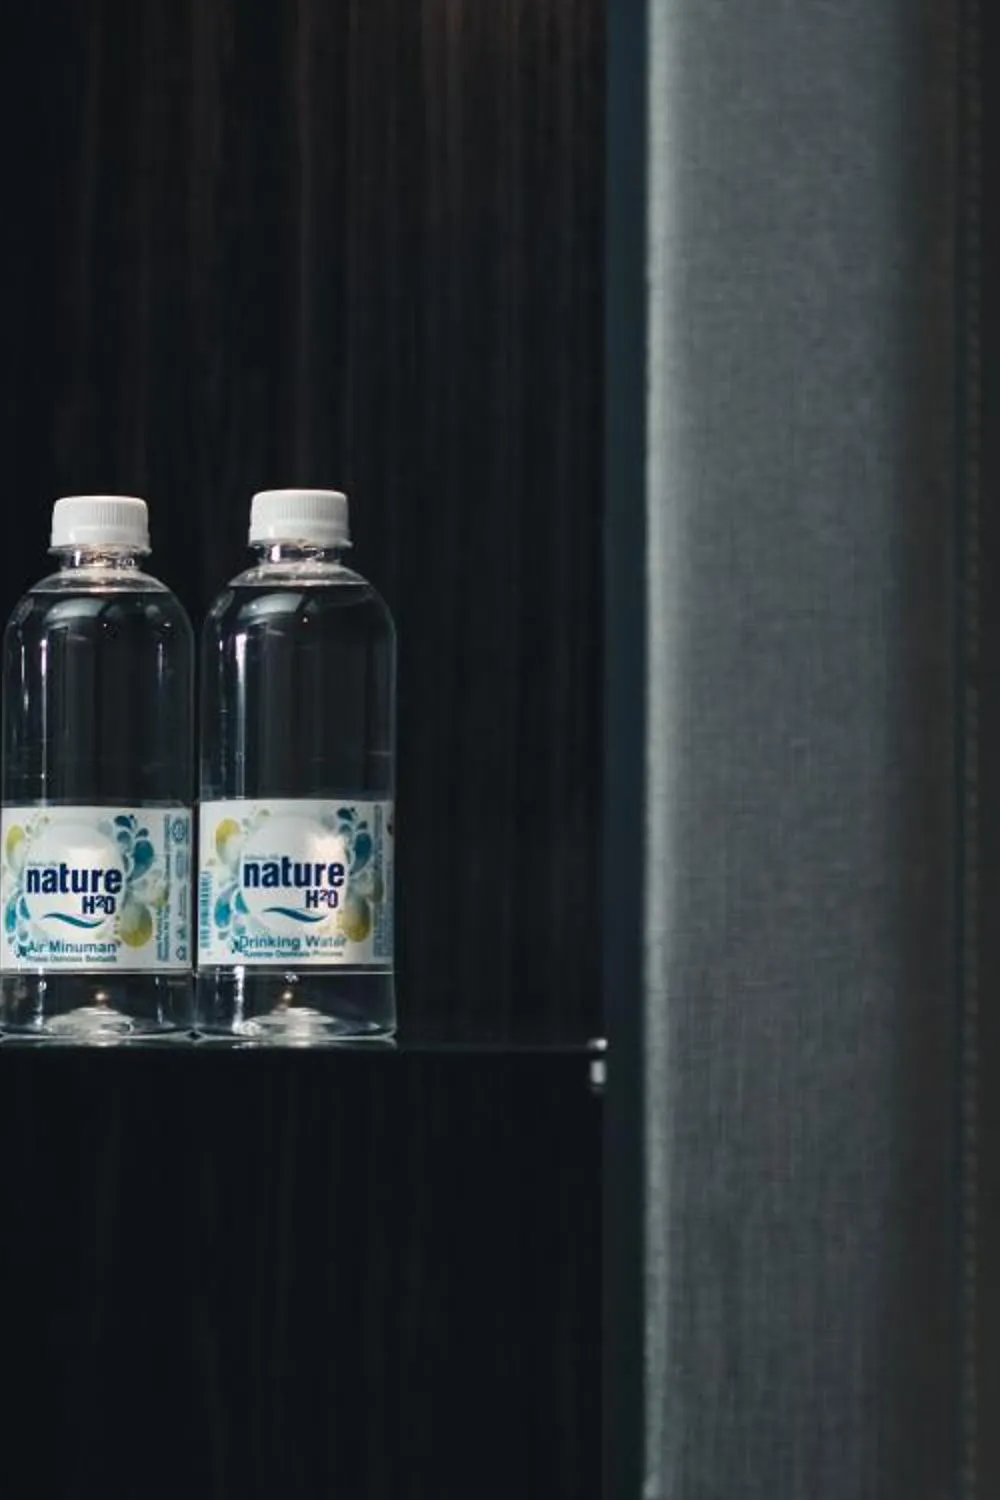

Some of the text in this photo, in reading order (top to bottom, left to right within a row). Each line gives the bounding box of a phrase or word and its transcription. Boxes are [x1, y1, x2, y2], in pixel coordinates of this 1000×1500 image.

[27, 863, 122, 894] nature
[244, 856, 345, 888] nature
[28, 939, 116, 953] Air Minuman
[239, 936, 300, 950] Drinking
